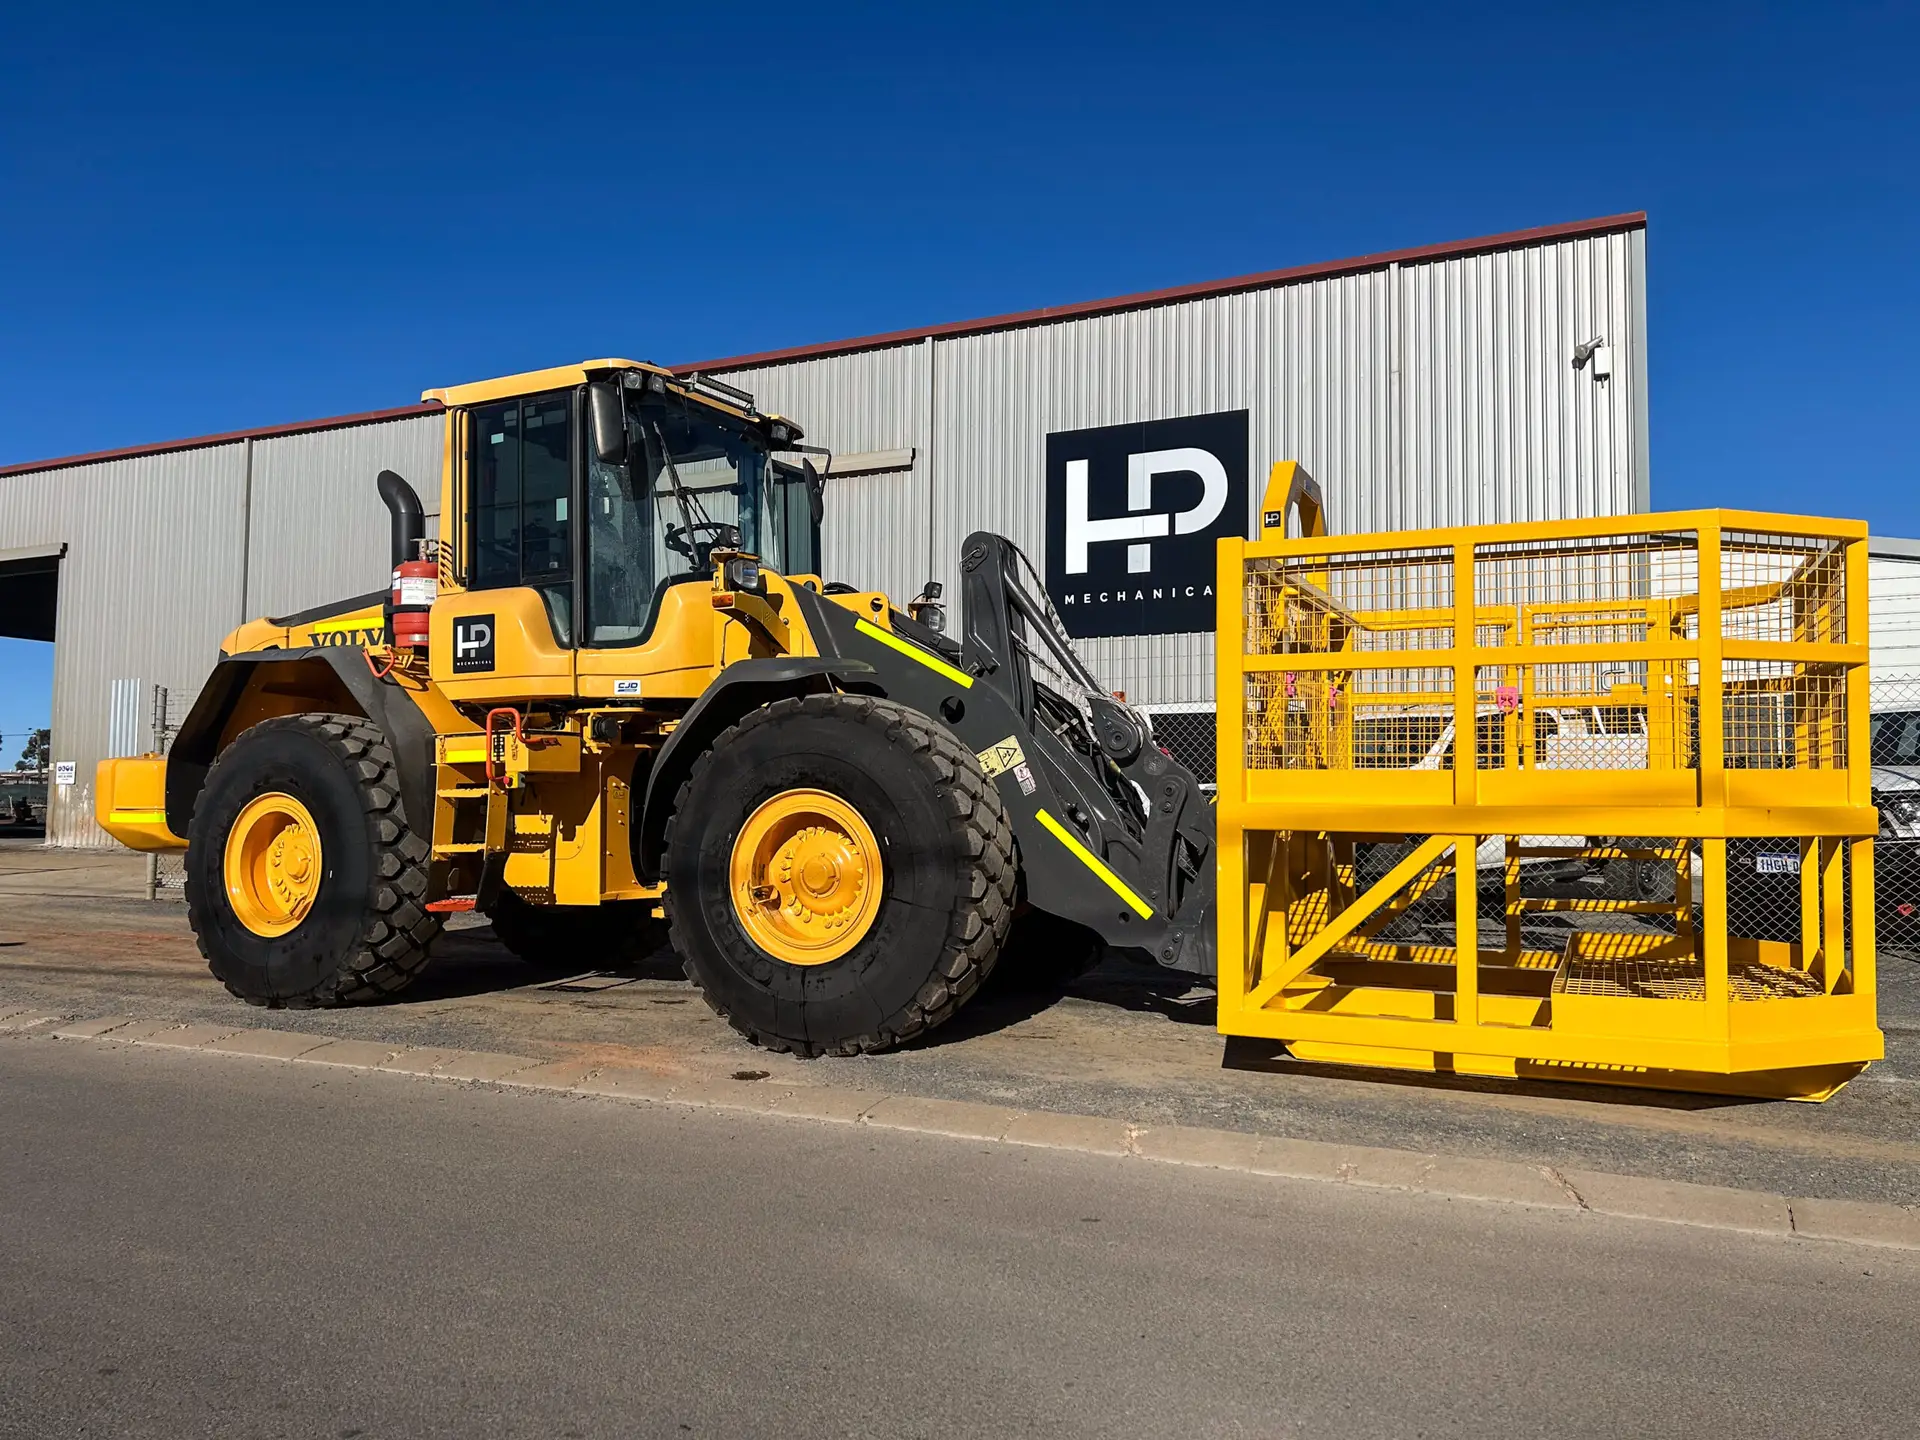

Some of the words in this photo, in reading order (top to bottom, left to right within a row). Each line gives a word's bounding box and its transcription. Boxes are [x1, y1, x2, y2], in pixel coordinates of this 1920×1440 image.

[1066, 447, 1229, 575] HP
[1065, 585, 1213, 605] MECHANICA
[308, 627, 384, 647] VOLV
[457, 623, 491, 657] HP
